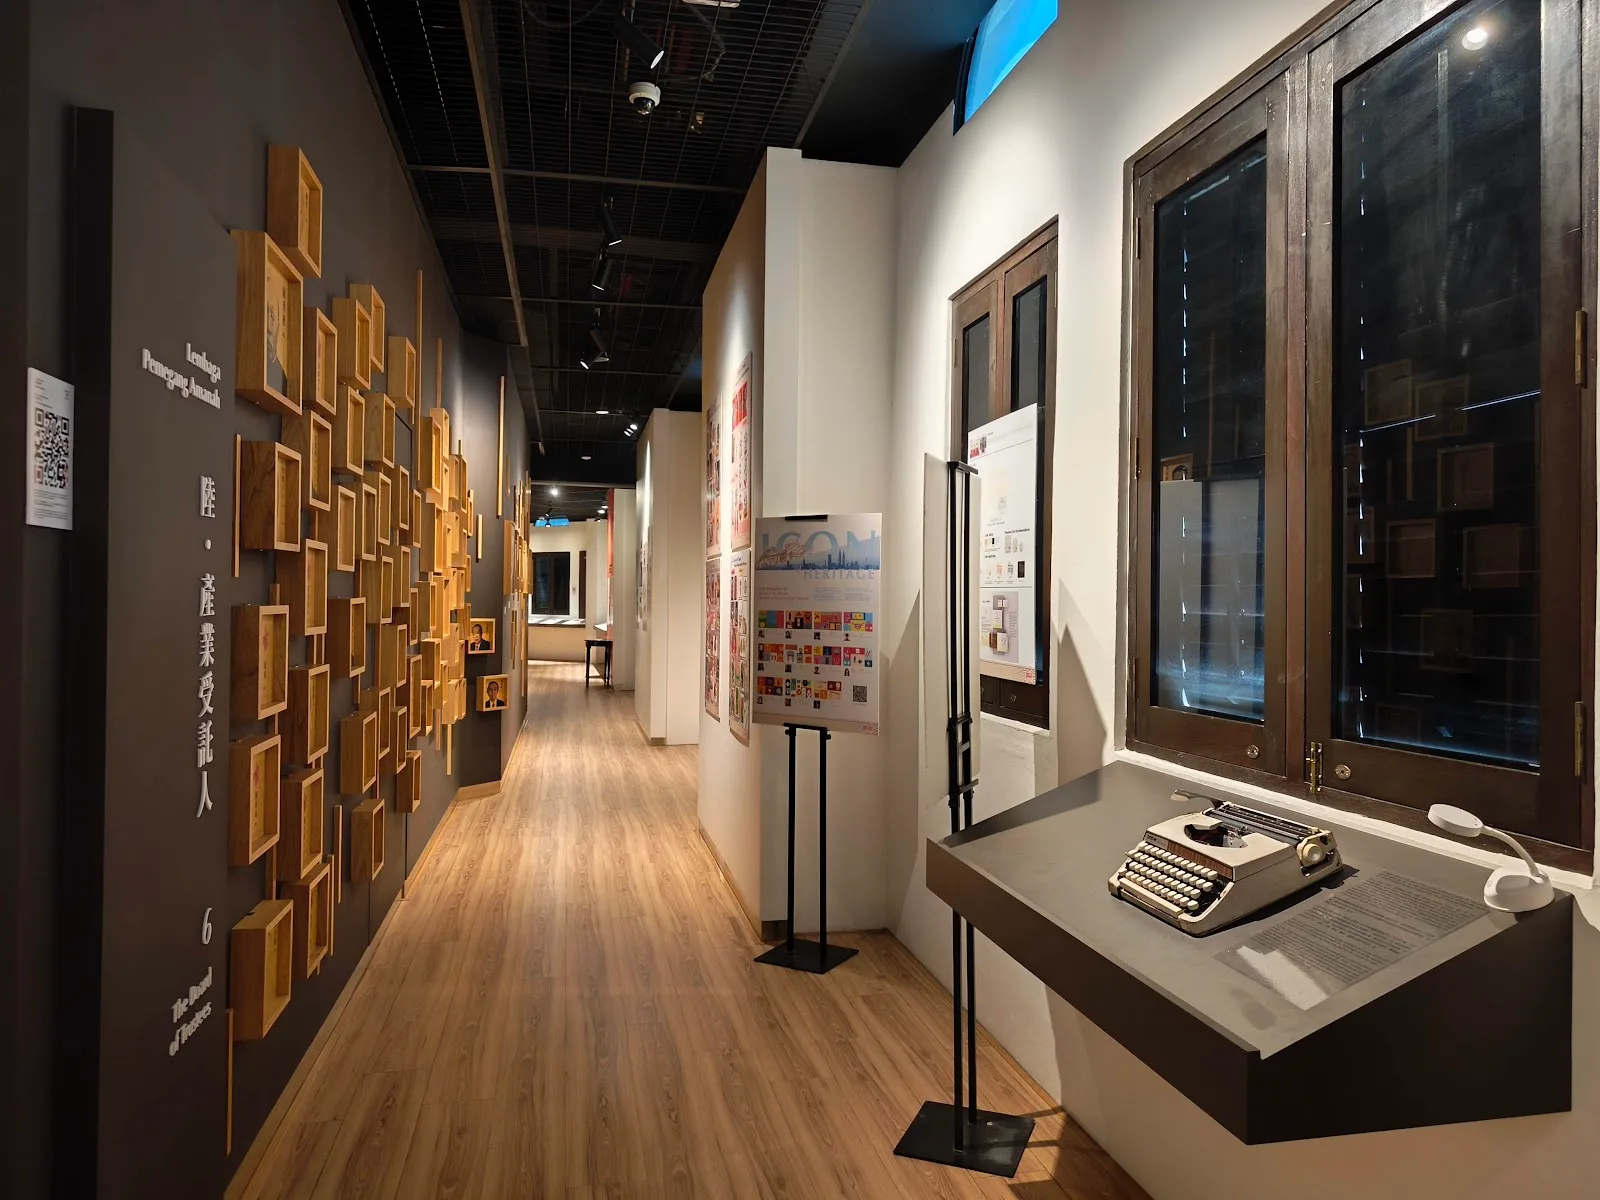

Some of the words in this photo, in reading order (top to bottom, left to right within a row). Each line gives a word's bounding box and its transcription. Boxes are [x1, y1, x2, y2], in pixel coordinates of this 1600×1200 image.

[142, 348, 189, 398] Pemegang
[189, 376, 221, 409] Amanah
[186, 342, 221, 384] Lembaga
[803, 569, 876, 580] HERITAGE
[202, 907, 212, 944] 6
